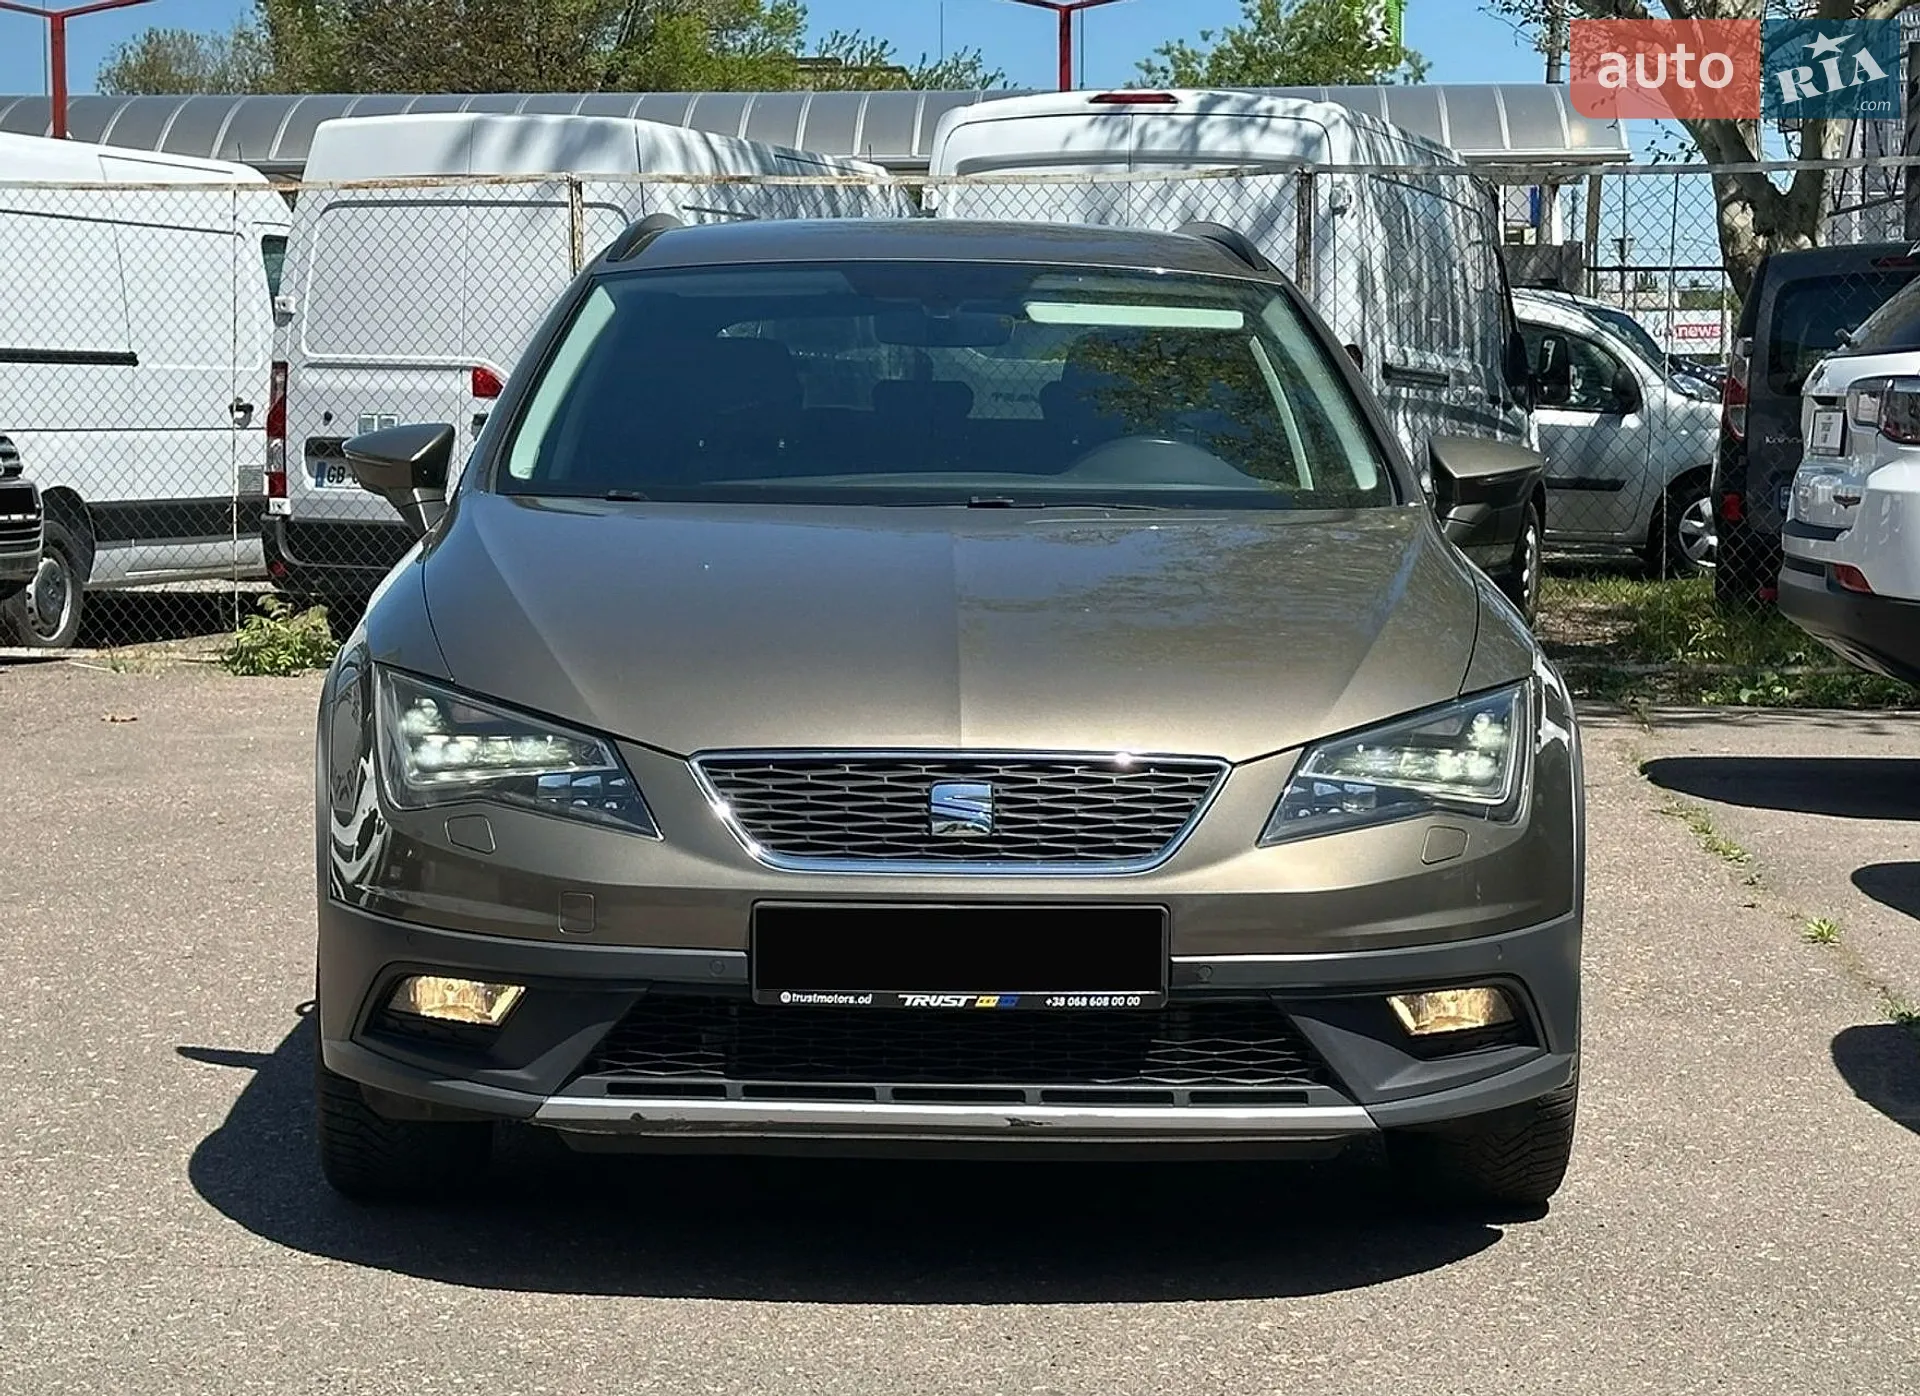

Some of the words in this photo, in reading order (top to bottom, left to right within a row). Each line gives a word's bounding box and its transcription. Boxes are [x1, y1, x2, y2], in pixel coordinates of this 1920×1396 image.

[898, 994, 977, 1007] TRUST
[1110, 996, 1125, 1007] 00
[1126, 996, 1141, 1007] 00
